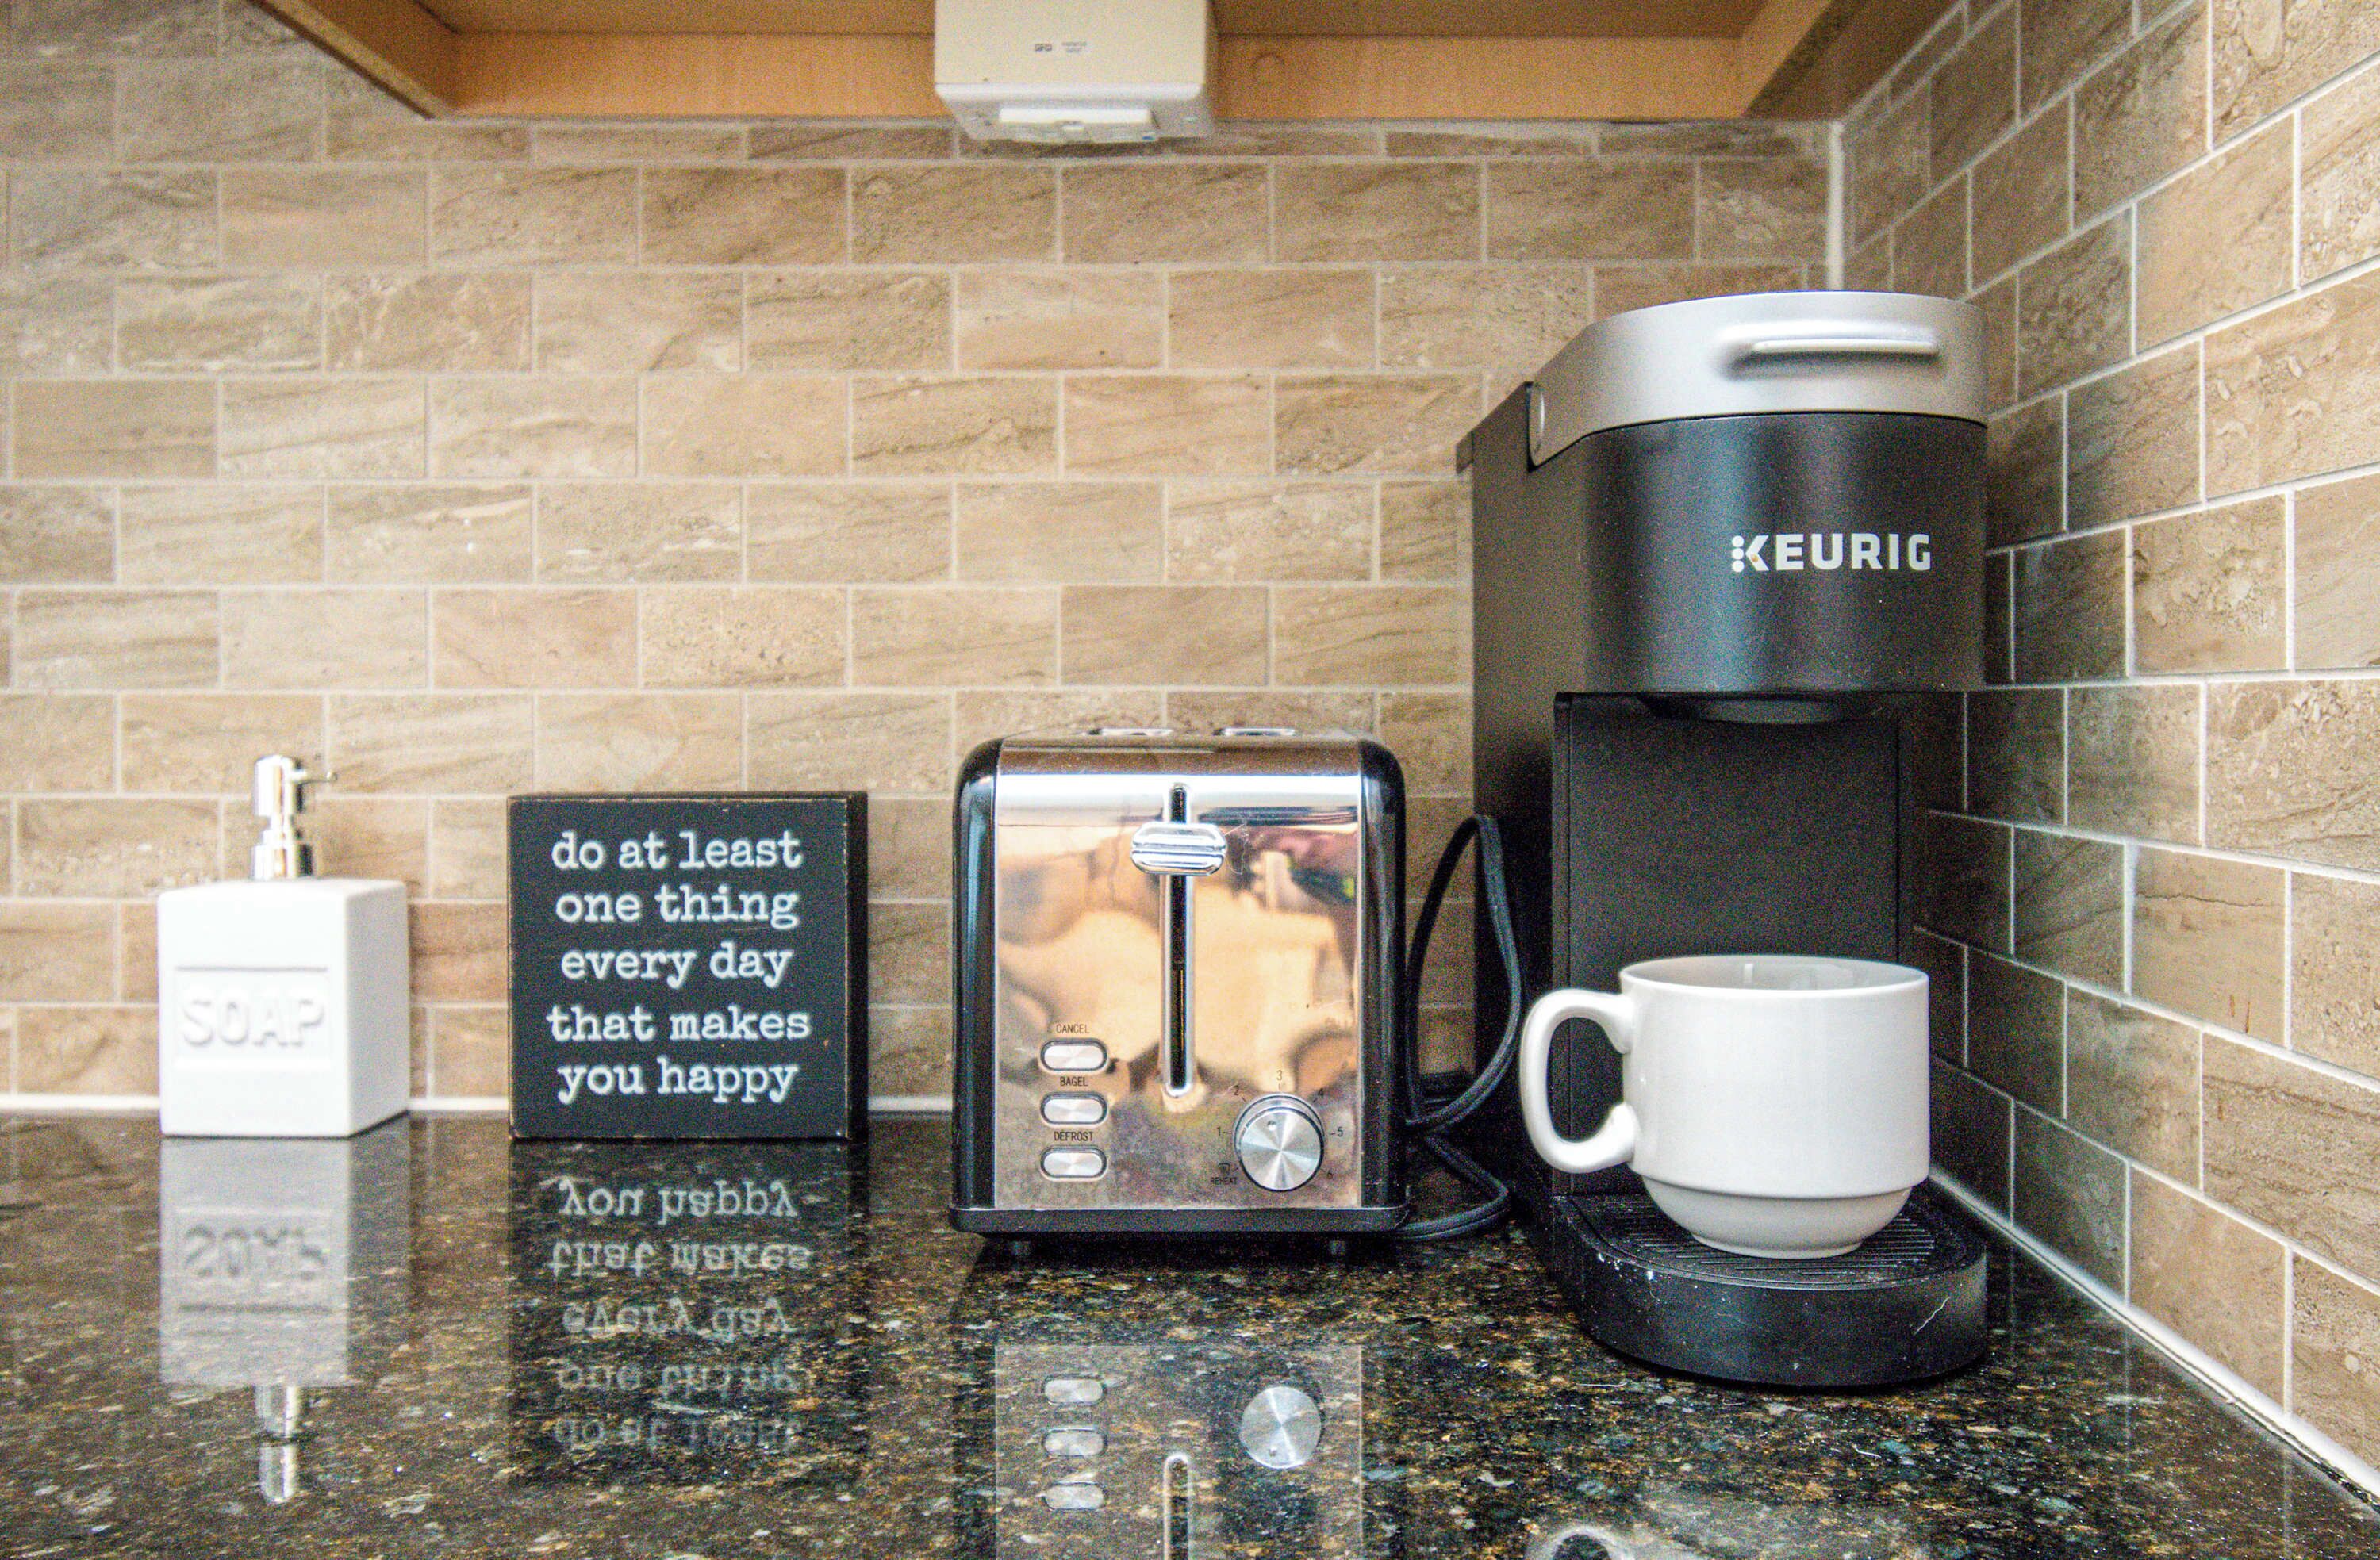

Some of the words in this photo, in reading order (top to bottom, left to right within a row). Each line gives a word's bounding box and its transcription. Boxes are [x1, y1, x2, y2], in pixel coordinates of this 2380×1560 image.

[1731, 533, 1931, 572] KEURIG
[551, 830, 607, 870] do
[618, 831, 670, 870] at
[678, 830, 804, 870] least
[555, 892, 641, 922] one
[655, 884, 799, 930] thing
[561, 949, 697, 989] every
[710, 941, 793, 988] day
[182, 988, 325, 1047] SOAP
[546, 1005, 655, 1041] that
[670, 1004, 811, 1040] makes
[1056, 1024, 1090, 1033] CANCEL
[557, 1064, 646, 1104] you
[656, 1055, 798, 1103] happy
[1060, 1076, 1088, 1087] BAGEL
[1276, 1070, 1283, 1080] 3
[1233, 1085, 1240, 1095] 2
[1054, 1131, 1094, 1141] DEFROST
[1337, 1126, 1344, 1136] 5
[1210, 1177, 1238, 1186] REHEAT
